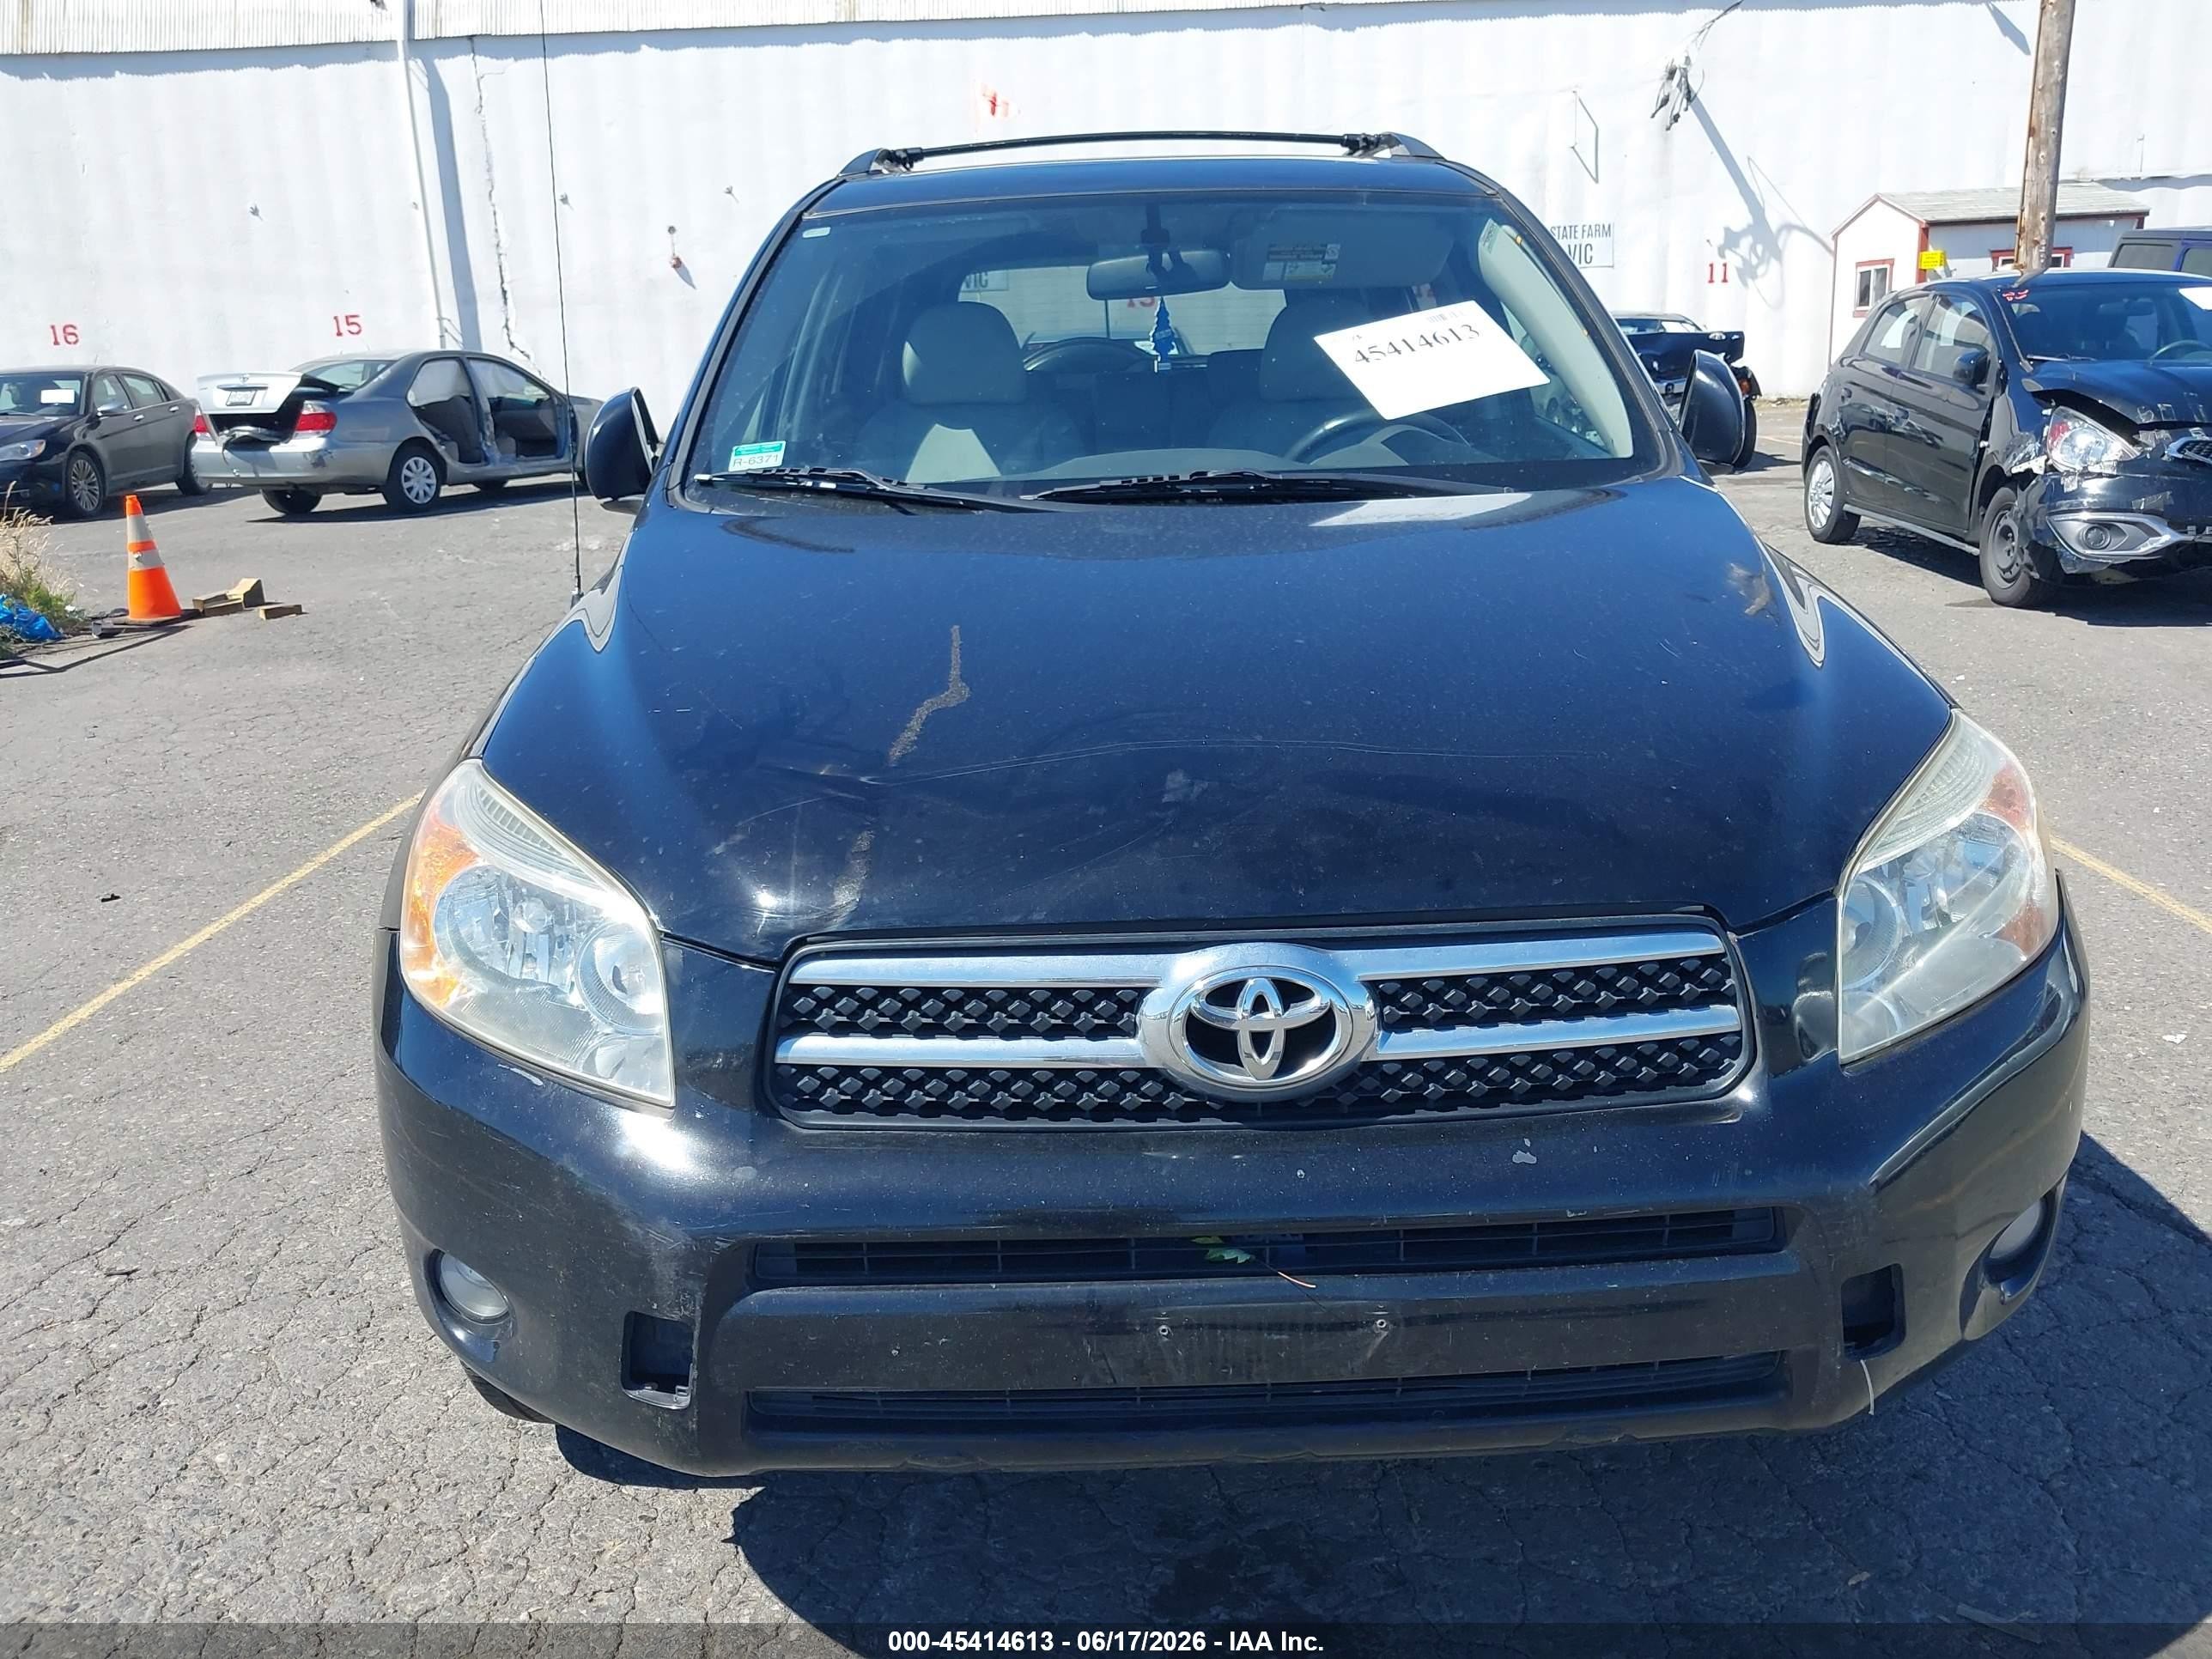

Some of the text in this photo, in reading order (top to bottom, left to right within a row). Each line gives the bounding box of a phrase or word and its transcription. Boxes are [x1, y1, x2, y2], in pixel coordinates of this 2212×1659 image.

[1550, 222, 1612, 240] STATE FARM
[1567, 243, 1594, 265] VIC
[1707, 262, 1729, 284] 11
[50, 324, 79, 346] 16
[333, 314, 362, 337] 15
[1355, 324, 1480, 363] 45414613
[732, 453, 779, 468] R-6371
